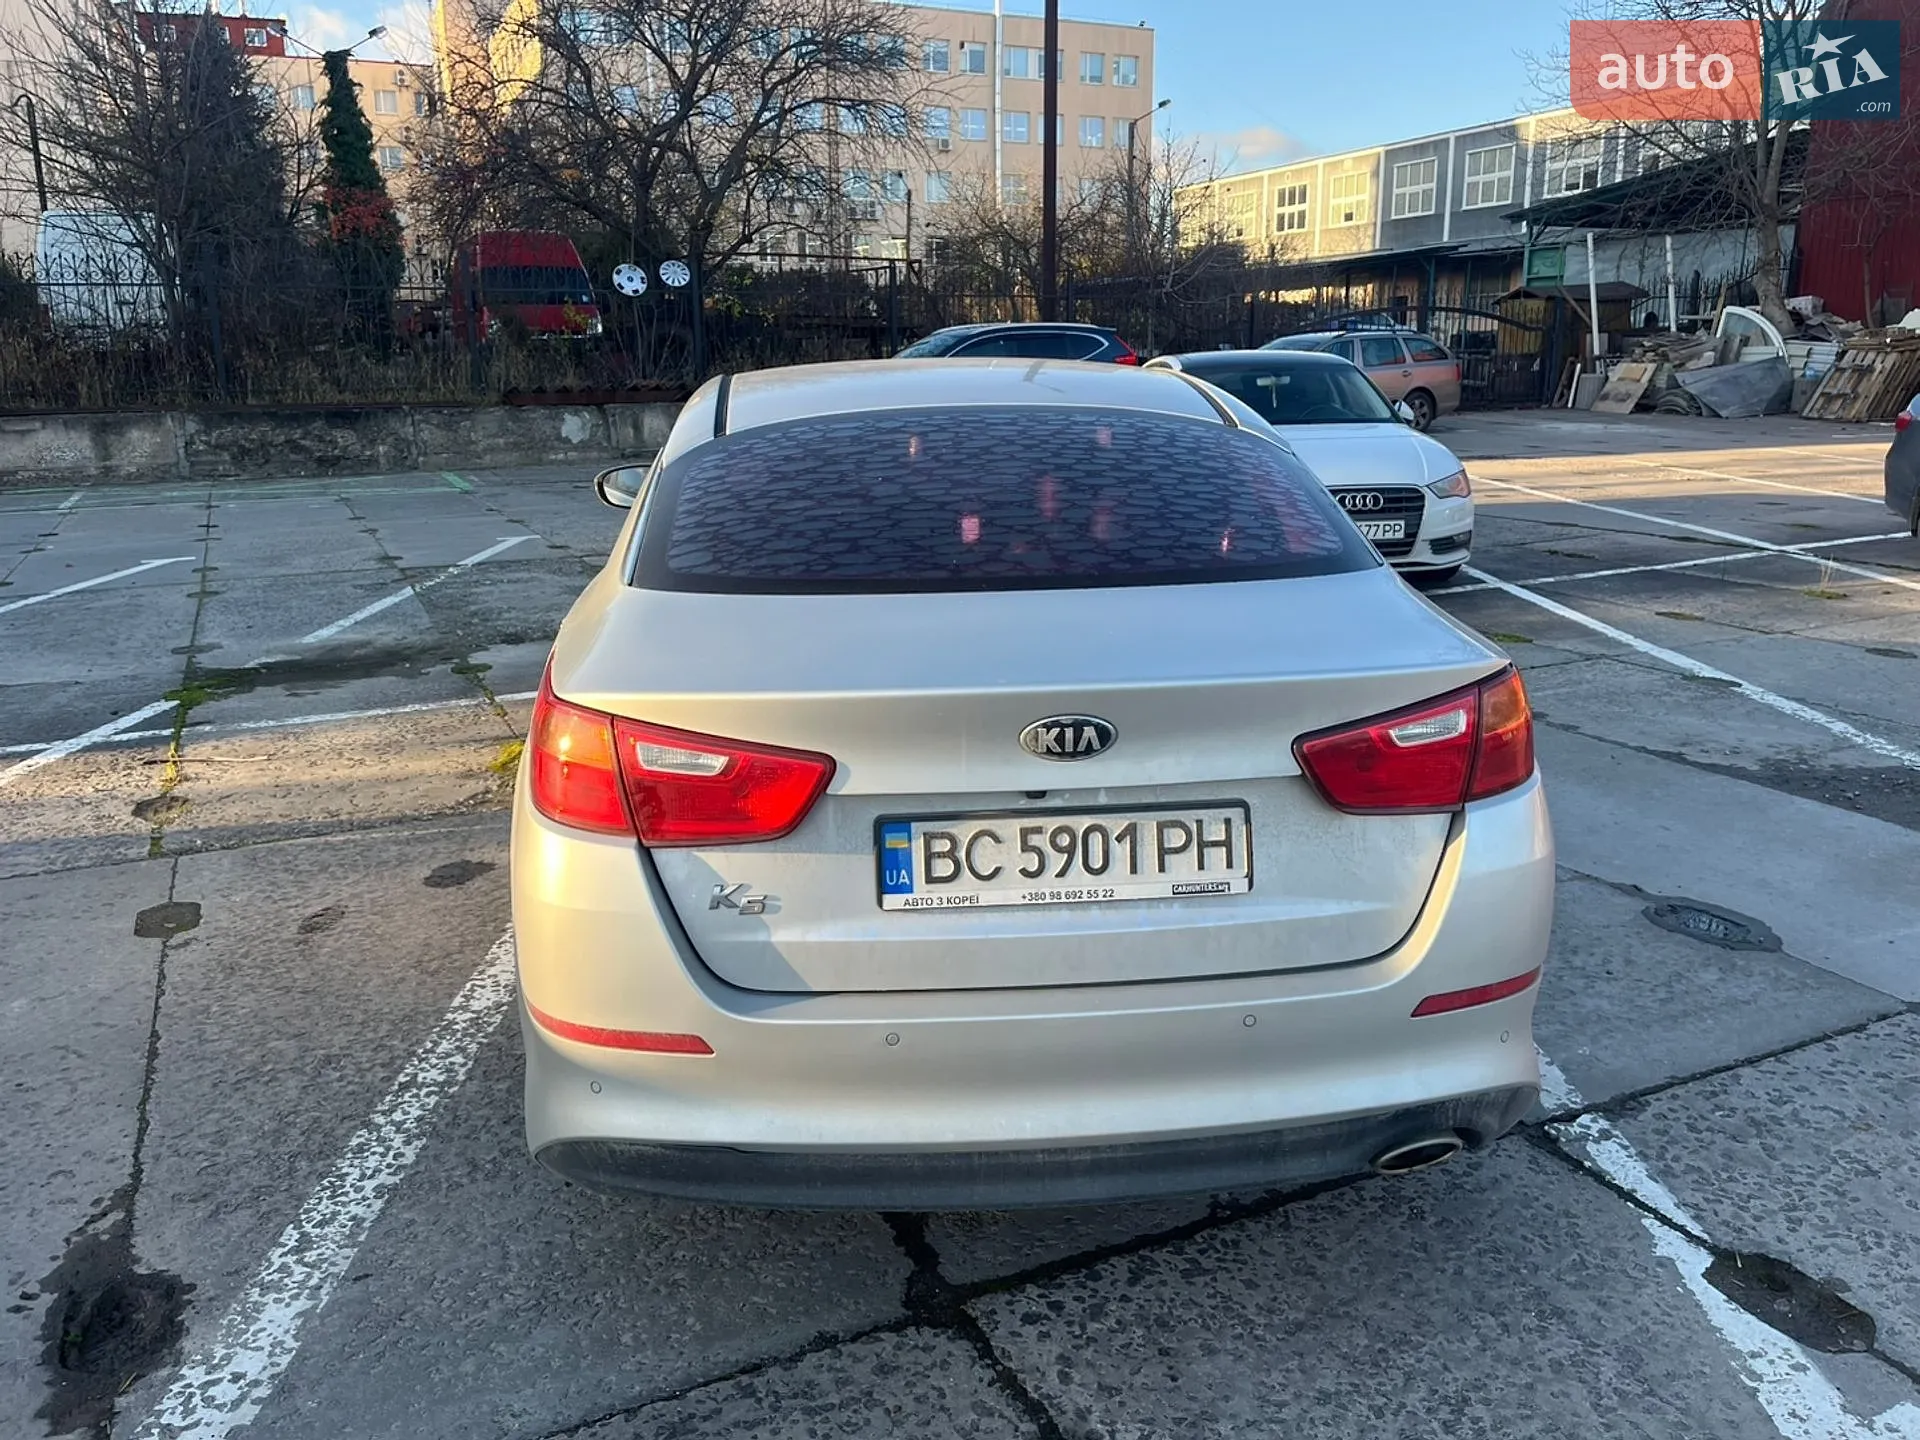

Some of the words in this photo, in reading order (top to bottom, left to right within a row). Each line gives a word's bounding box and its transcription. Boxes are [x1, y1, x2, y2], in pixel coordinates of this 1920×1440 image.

[1358, 523, 1380, 538] 77
[1036, 725, 1101, 753] KIA
[922, 828, 1002, 885] BC
[1017, 821, 1137, 879] 5901
[1156, 817, 1233, 874] PH
[885, 869, 911, 886] UA
[708, 883, 768, 915] K5
[903, 897, 934, 907] АВТО
[1021, 891, 1047, 902] +380
[1049, 890, 1062, 900] 98
[1064, 889, 1084, 900] 692
[1086, 889, 1099, 899] 55
[1101, 888, 1115, 898] 22
